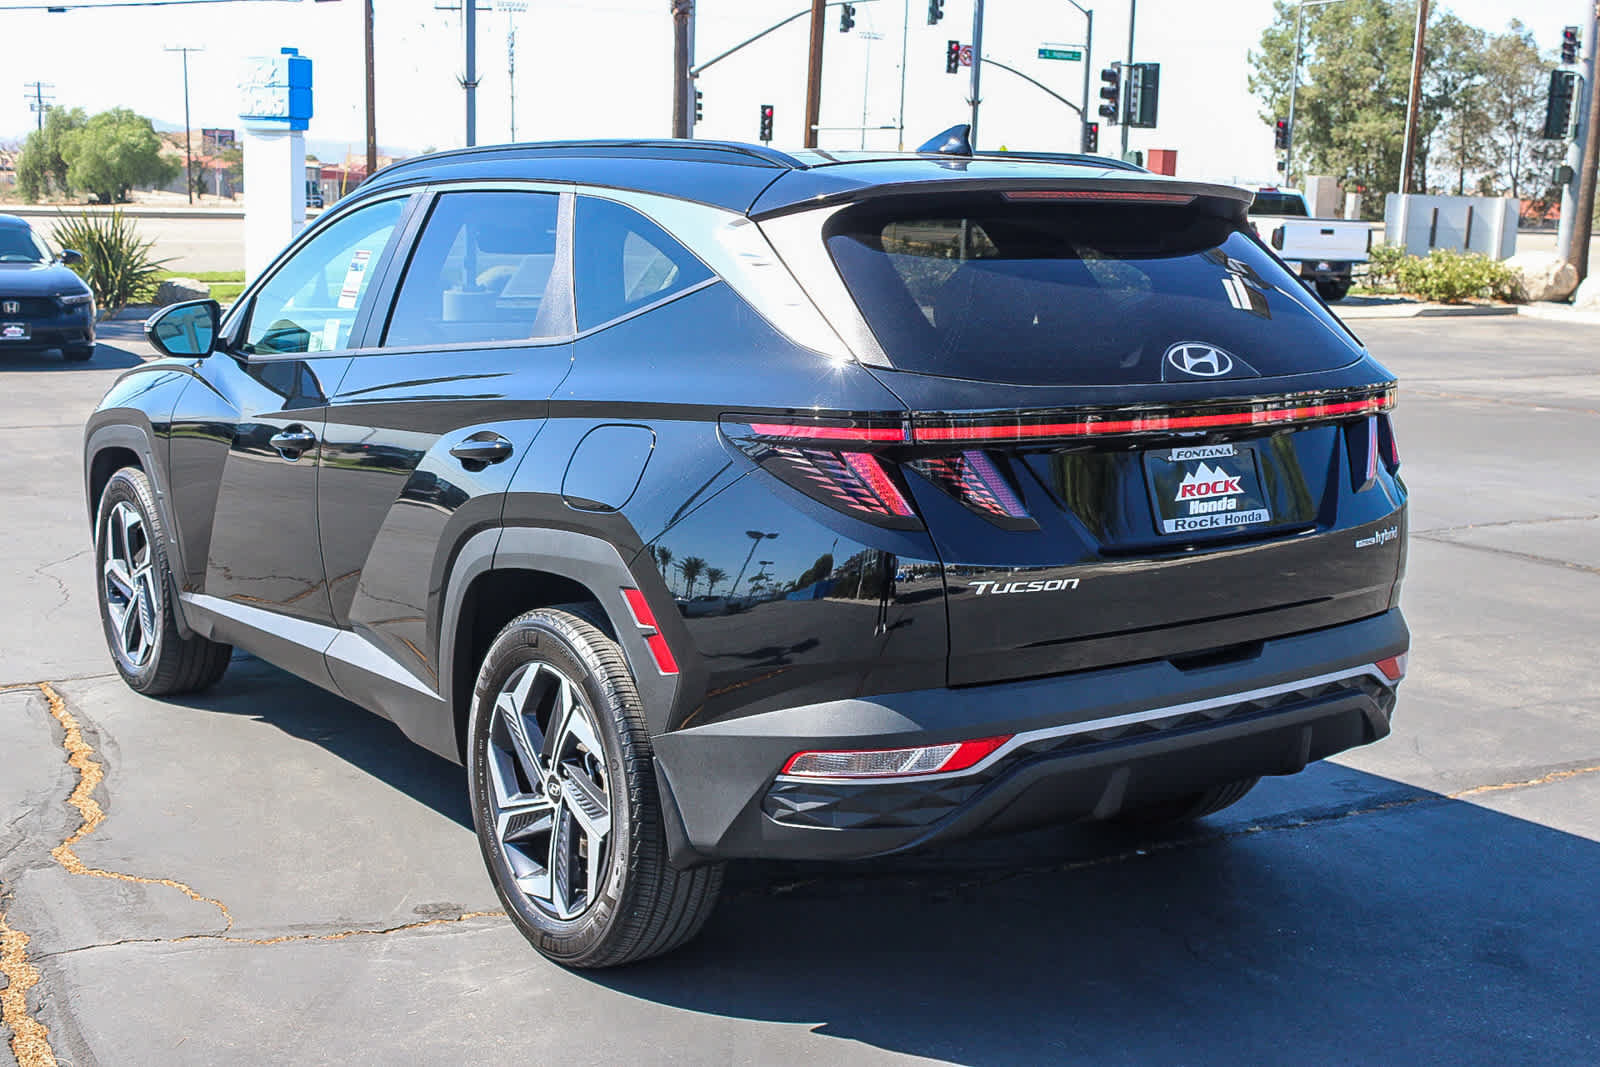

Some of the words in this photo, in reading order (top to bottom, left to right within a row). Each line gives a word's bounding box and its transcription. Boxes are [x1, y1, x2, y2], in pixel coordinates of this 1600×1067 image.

[1176, 447, 1232, 460] FONTANA
[1181, 479, 1239, 498] ROCK
[1189, 497, 1237, 515] Honda
[1174, 516, 1220, 531] Rock
[1224, 512, 1262, 525] Honda
